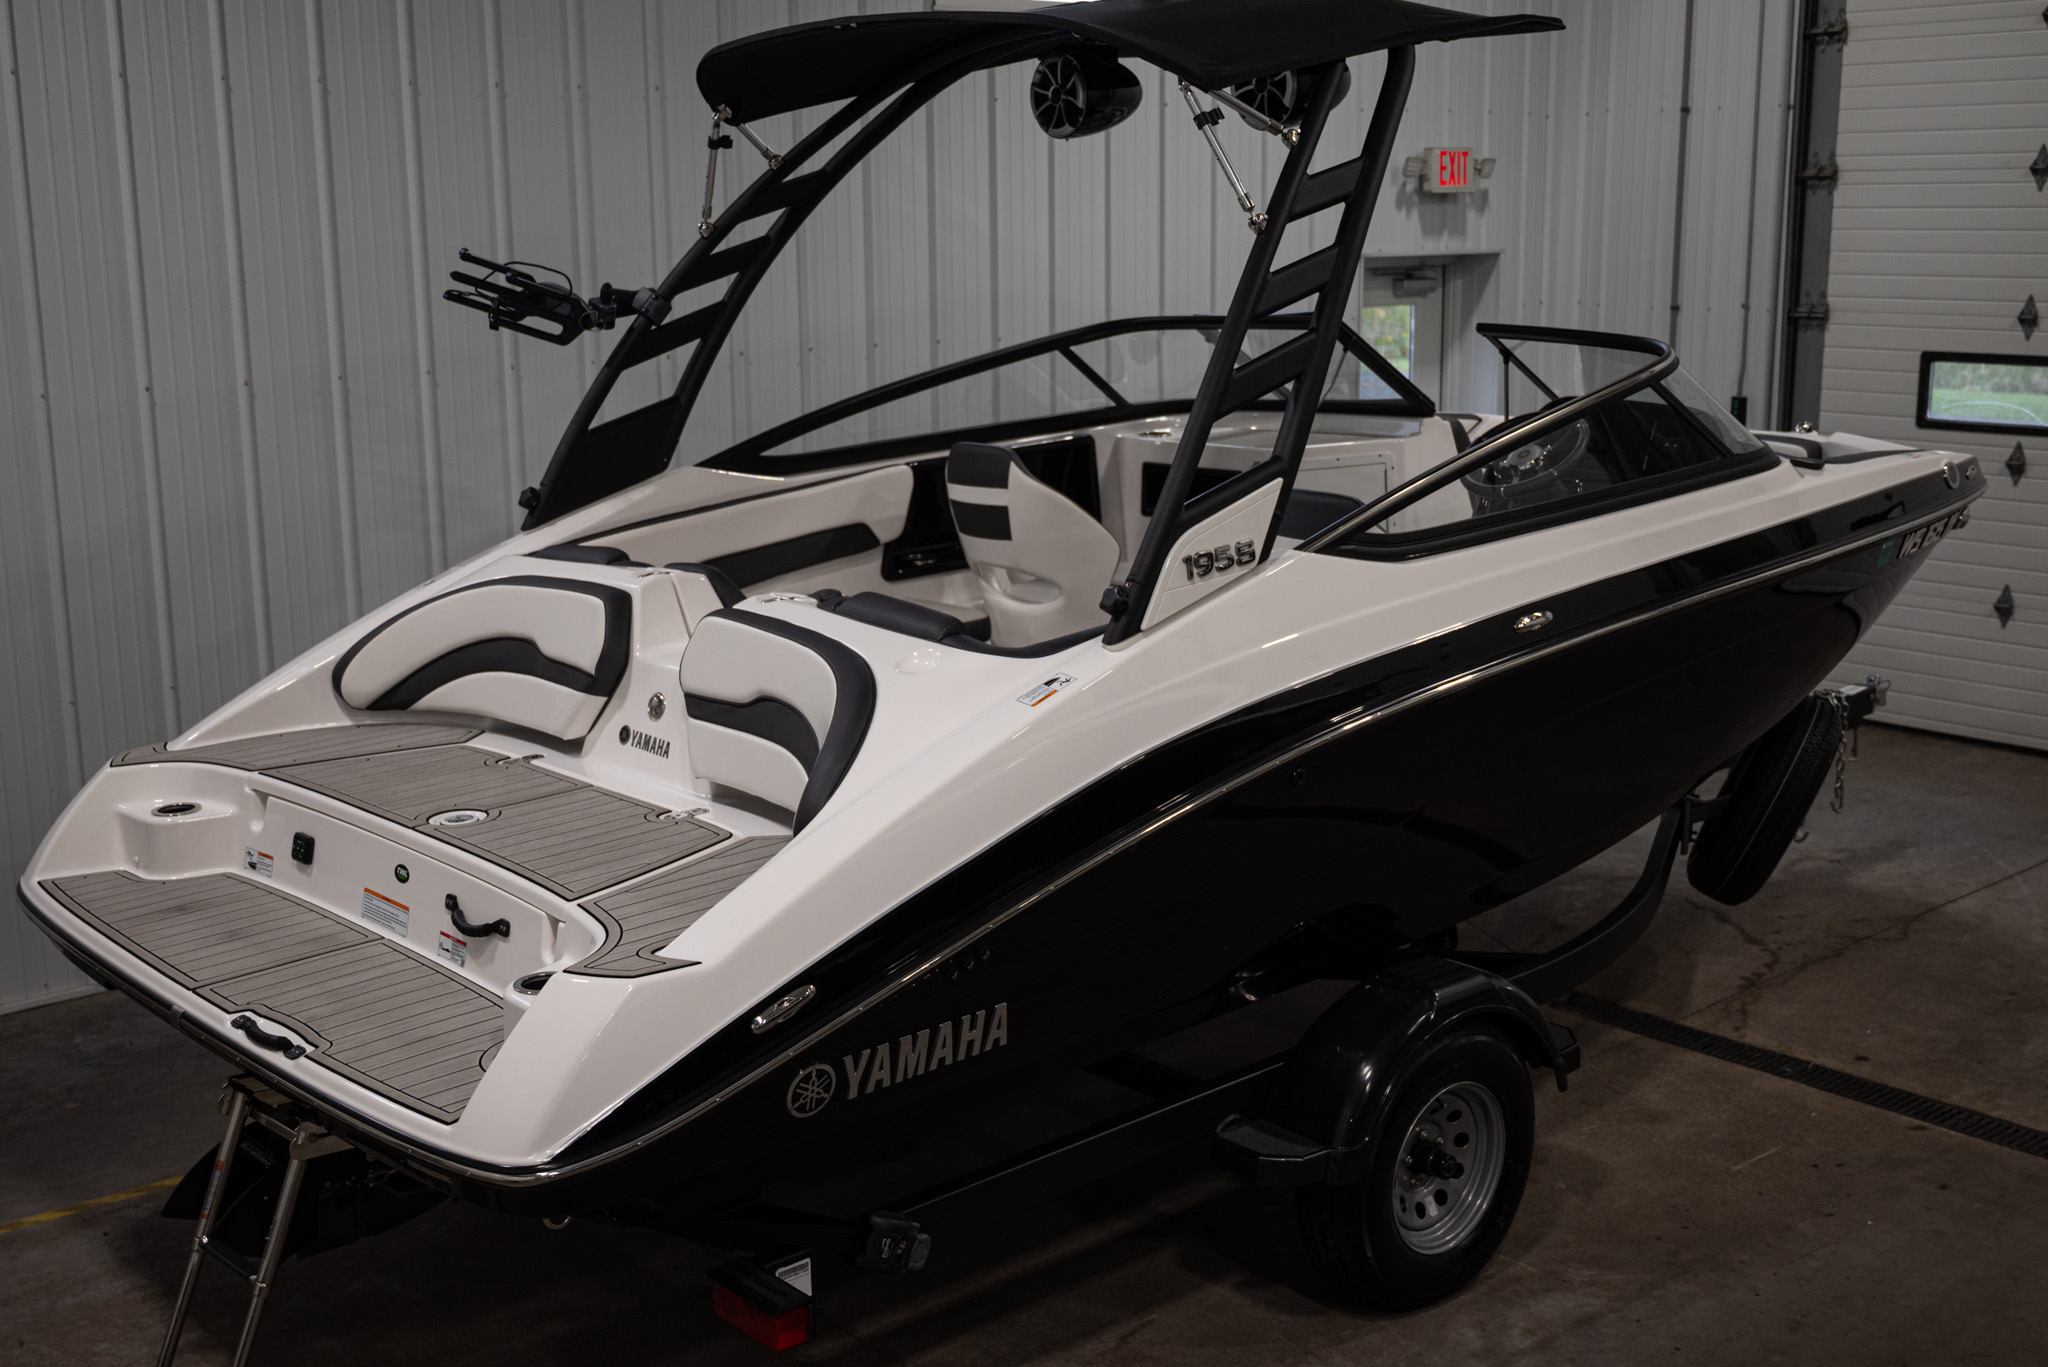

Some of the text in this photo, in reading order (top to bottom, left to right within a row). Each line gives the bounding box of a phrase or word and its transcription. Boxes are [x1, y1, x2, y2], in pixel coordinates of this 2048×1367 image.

[1440, 150, 1469, 186] EXIT
[630, 728, 671, 760] YAMAHA
[842, 1001, 1009, 1101] YAMAHA
